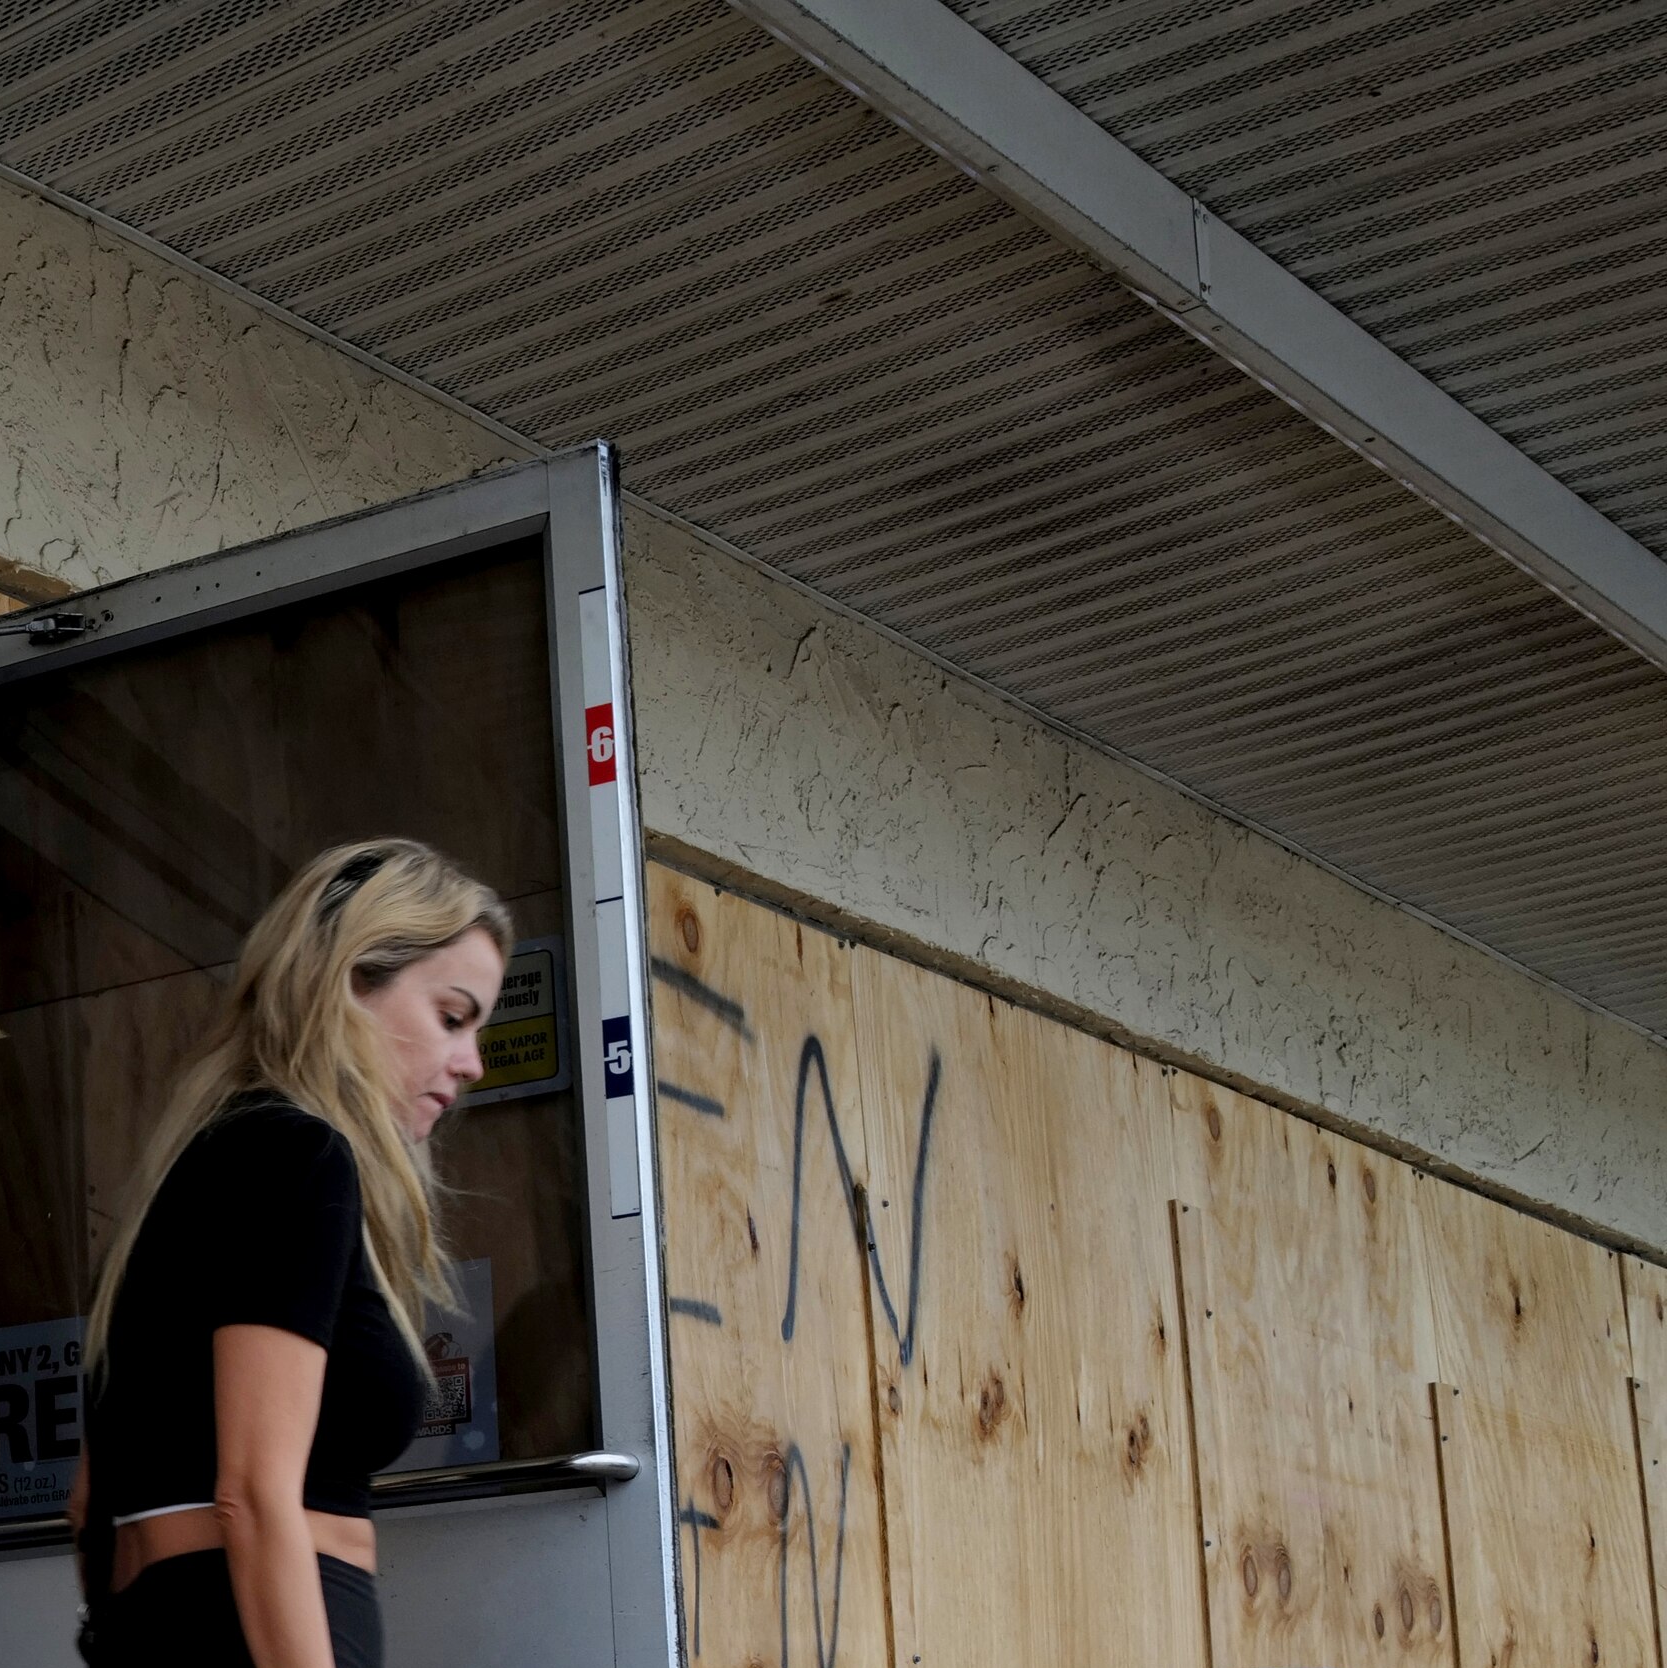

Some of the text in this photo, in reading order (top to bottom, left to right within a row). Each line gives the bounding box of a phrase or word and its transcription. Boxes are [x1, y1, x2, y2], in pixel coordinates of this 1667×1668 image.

[591, 726, 614, 762] 6
[491, 1040, 506, 1052] OR
[509, 1032, 547, 1049] VAPOR
[489, 1048, 545, 1069] LEGAL AGE
[608, 1040, 631, 1074] 5
[36, 1345, 60, 1374] 2,
[14, 1478, 31, 1492] (12
[34, 1474, 56, 1490] oz.)
[30, 1494, 50, 1505] otro
[52, 1488, 72, 1501] GRA
